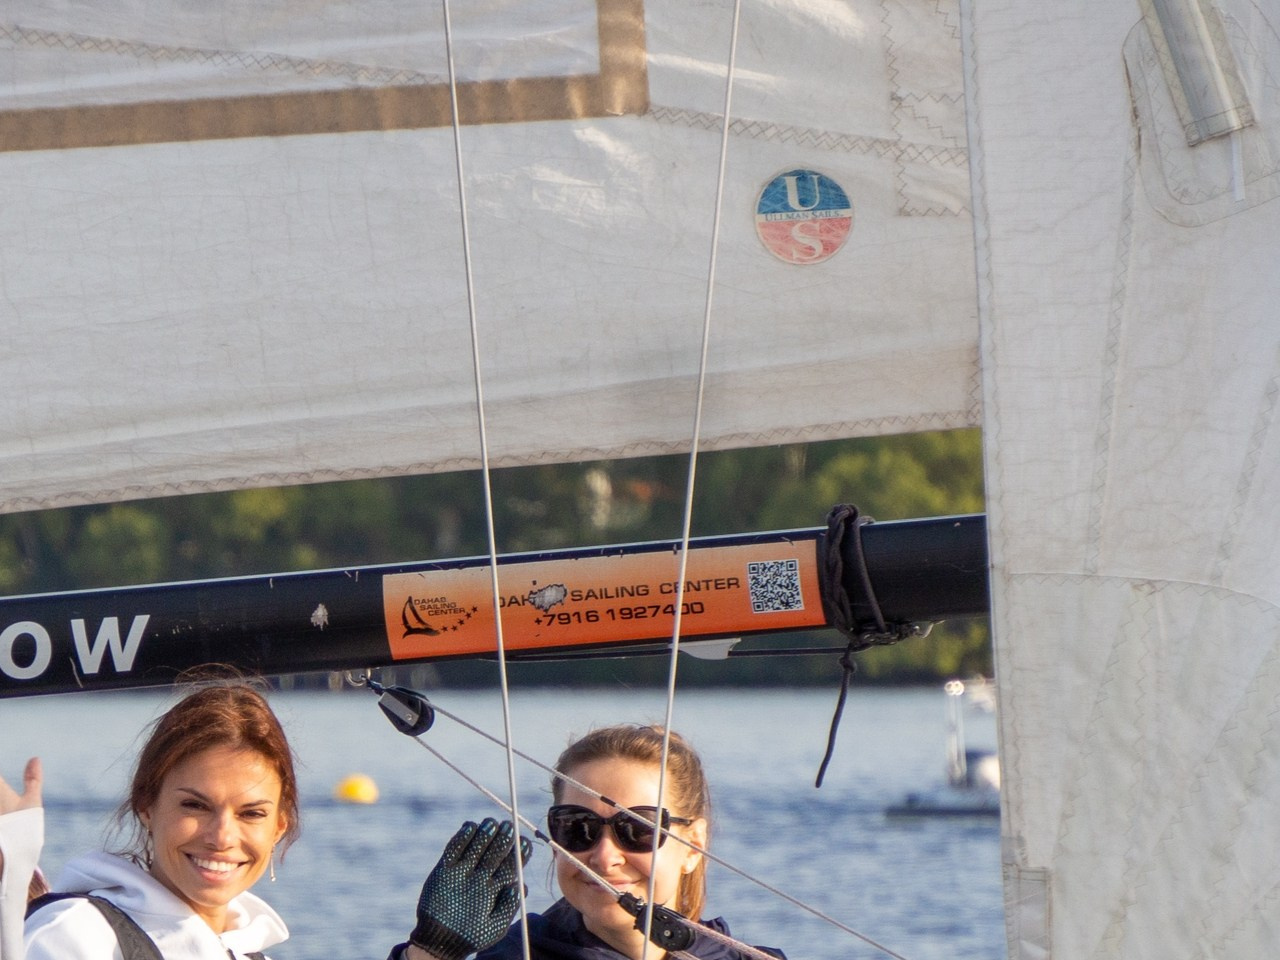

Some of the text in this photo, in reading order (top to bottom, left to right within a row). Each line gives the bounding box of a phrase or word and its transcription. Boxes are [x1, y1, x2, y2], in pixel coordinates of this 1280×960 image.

[783, 174, 821, 211] U
[792, 222, 824, 260] S
[570, 584, 650, 602] SAILING
[428, 608, 466, 617] CENTER
[534, 609, 600, 627] +7916
